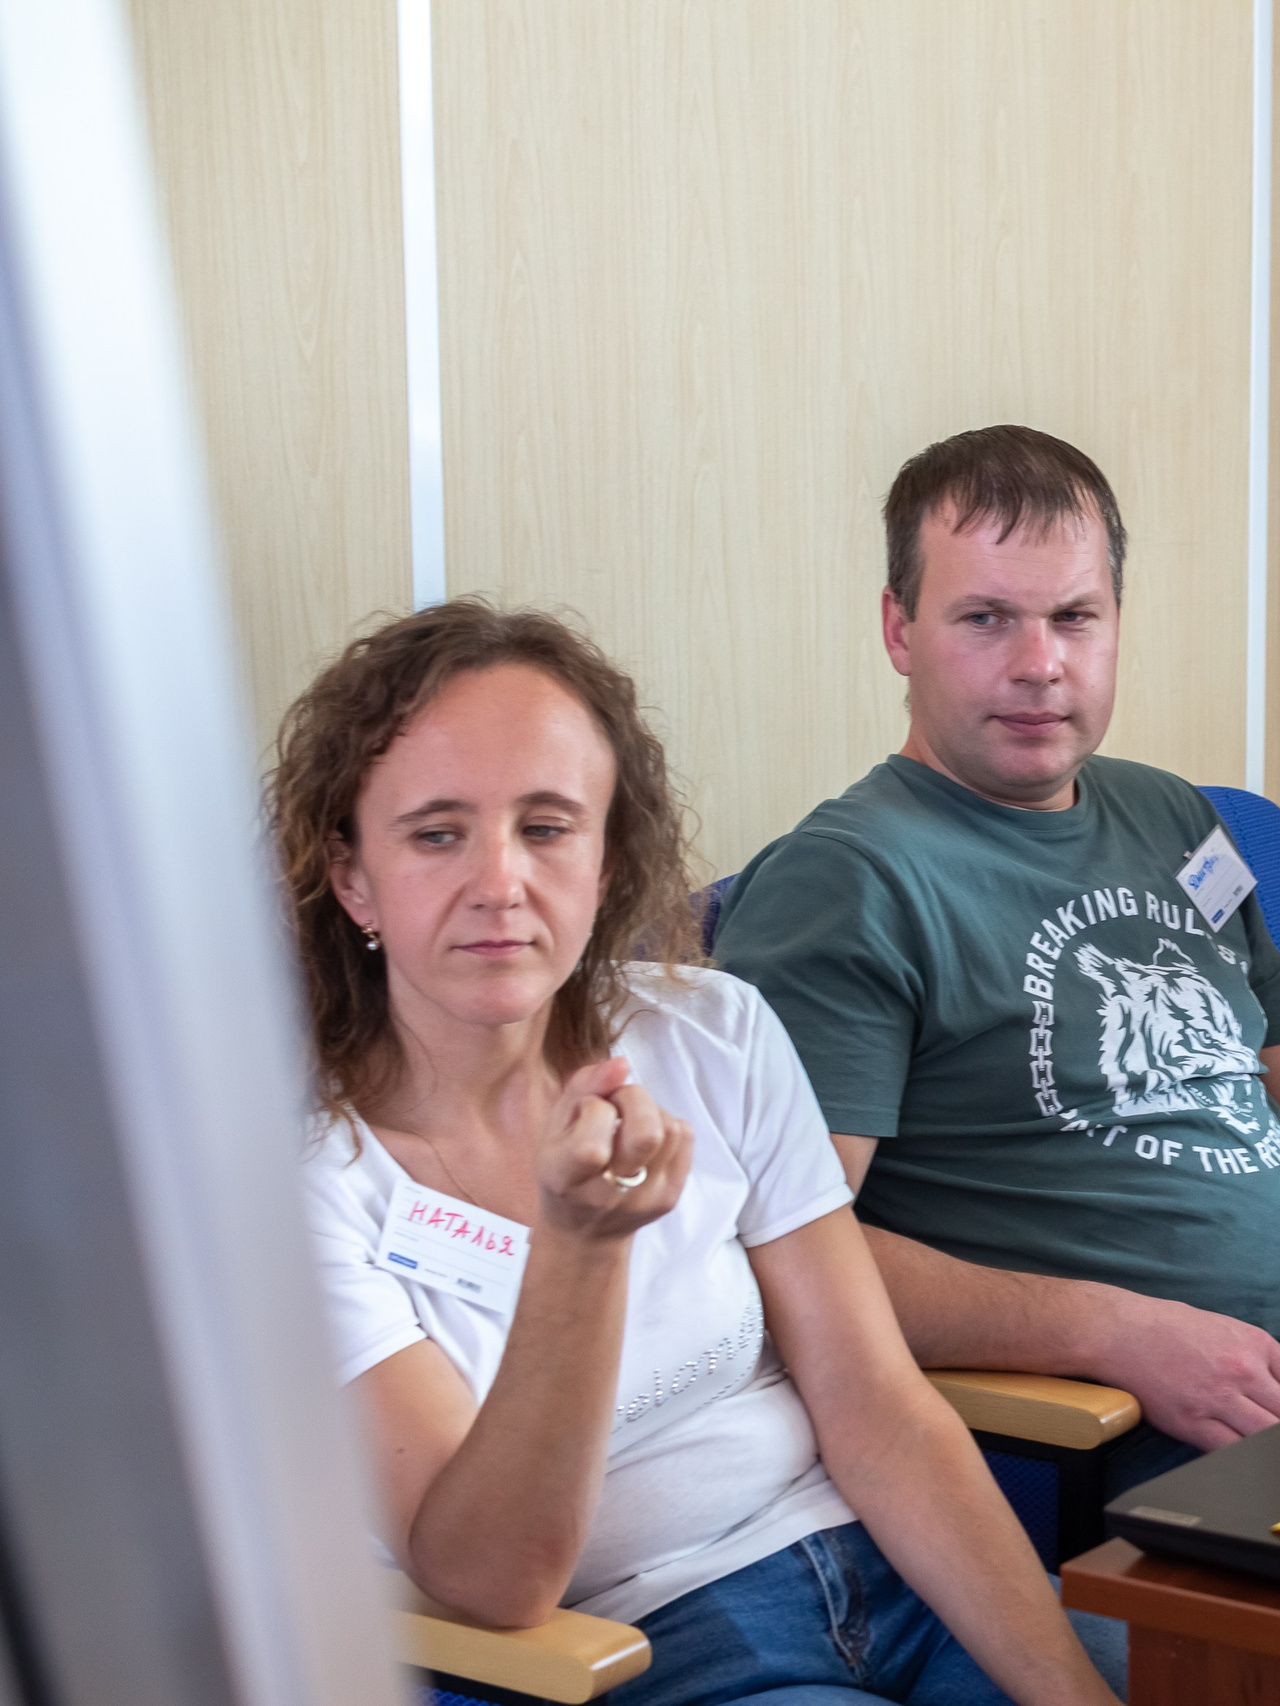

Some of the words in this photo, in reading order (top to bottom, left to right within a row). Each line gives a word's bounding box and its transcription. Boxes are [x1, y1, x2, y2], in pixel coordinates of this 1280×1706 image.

[1023, 886, 1139, 1000] BREAKING
[1144, 890, 1237, 965] RULS
[1135, 1134, 1184, 1166] OF
[1192, 1145, 1260, 1175] THE
